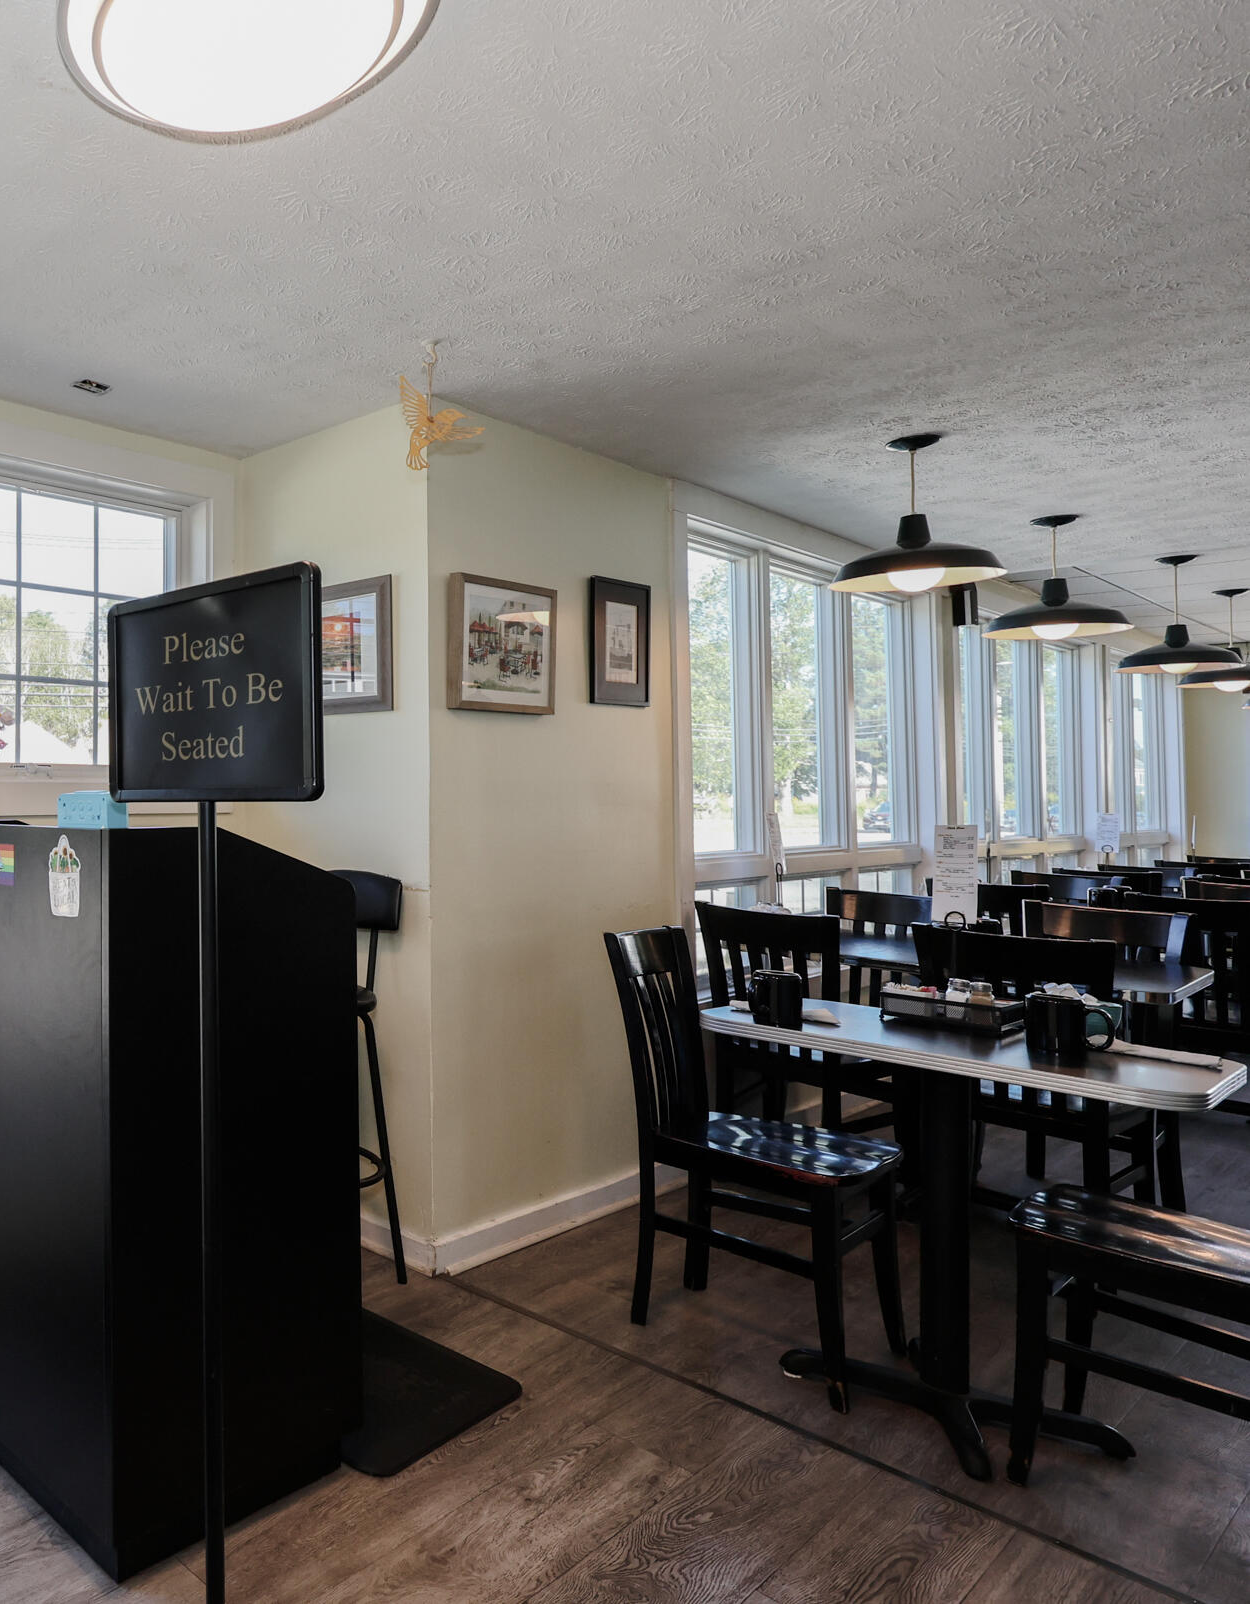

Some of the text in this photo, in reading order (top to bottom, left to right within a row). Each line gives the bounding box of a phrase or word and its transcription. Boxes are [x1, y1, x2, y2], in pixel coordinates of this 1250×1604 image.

[163, 632, 245, 665] Please
[134, 673, 284, 716] Wait To Be
[161, 725, 245, 762] Seated
